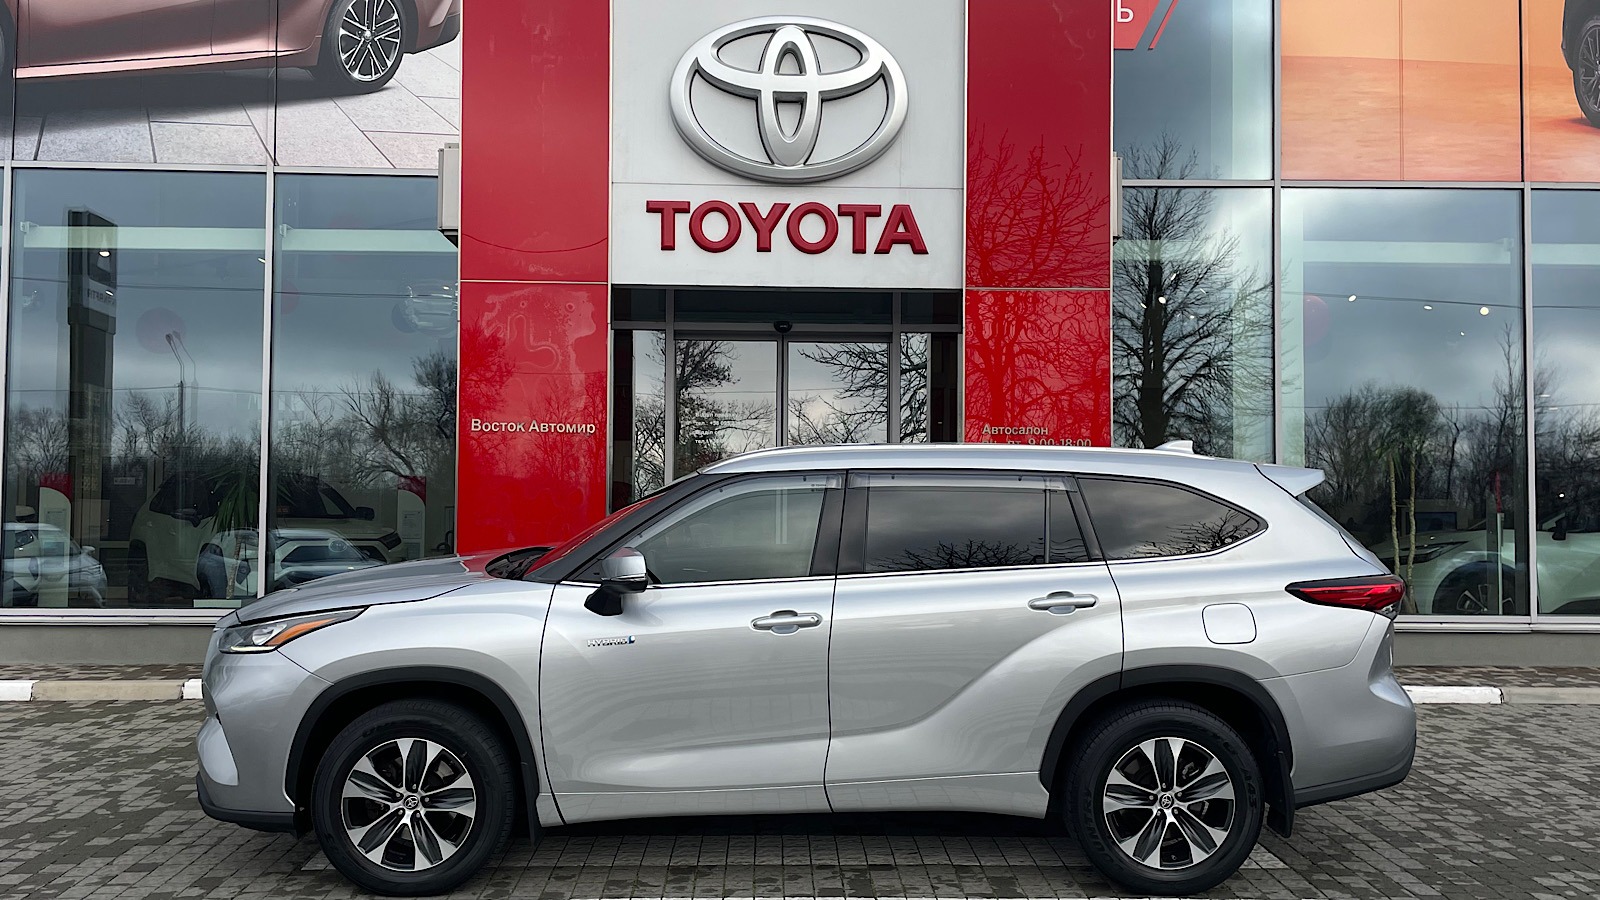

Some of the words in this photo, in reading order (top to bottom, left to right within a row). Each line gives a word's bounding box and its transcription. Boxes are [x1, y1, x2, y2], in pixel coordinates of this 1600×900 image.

[646, 200, 929, 254] TOYOTA
[471, 419, 526, 432] Восток
[528, 419, 596, 436] Автомир
[982, 424, 1048, 435] Автосалон
[587, 638, 628, 647] HYBRID
